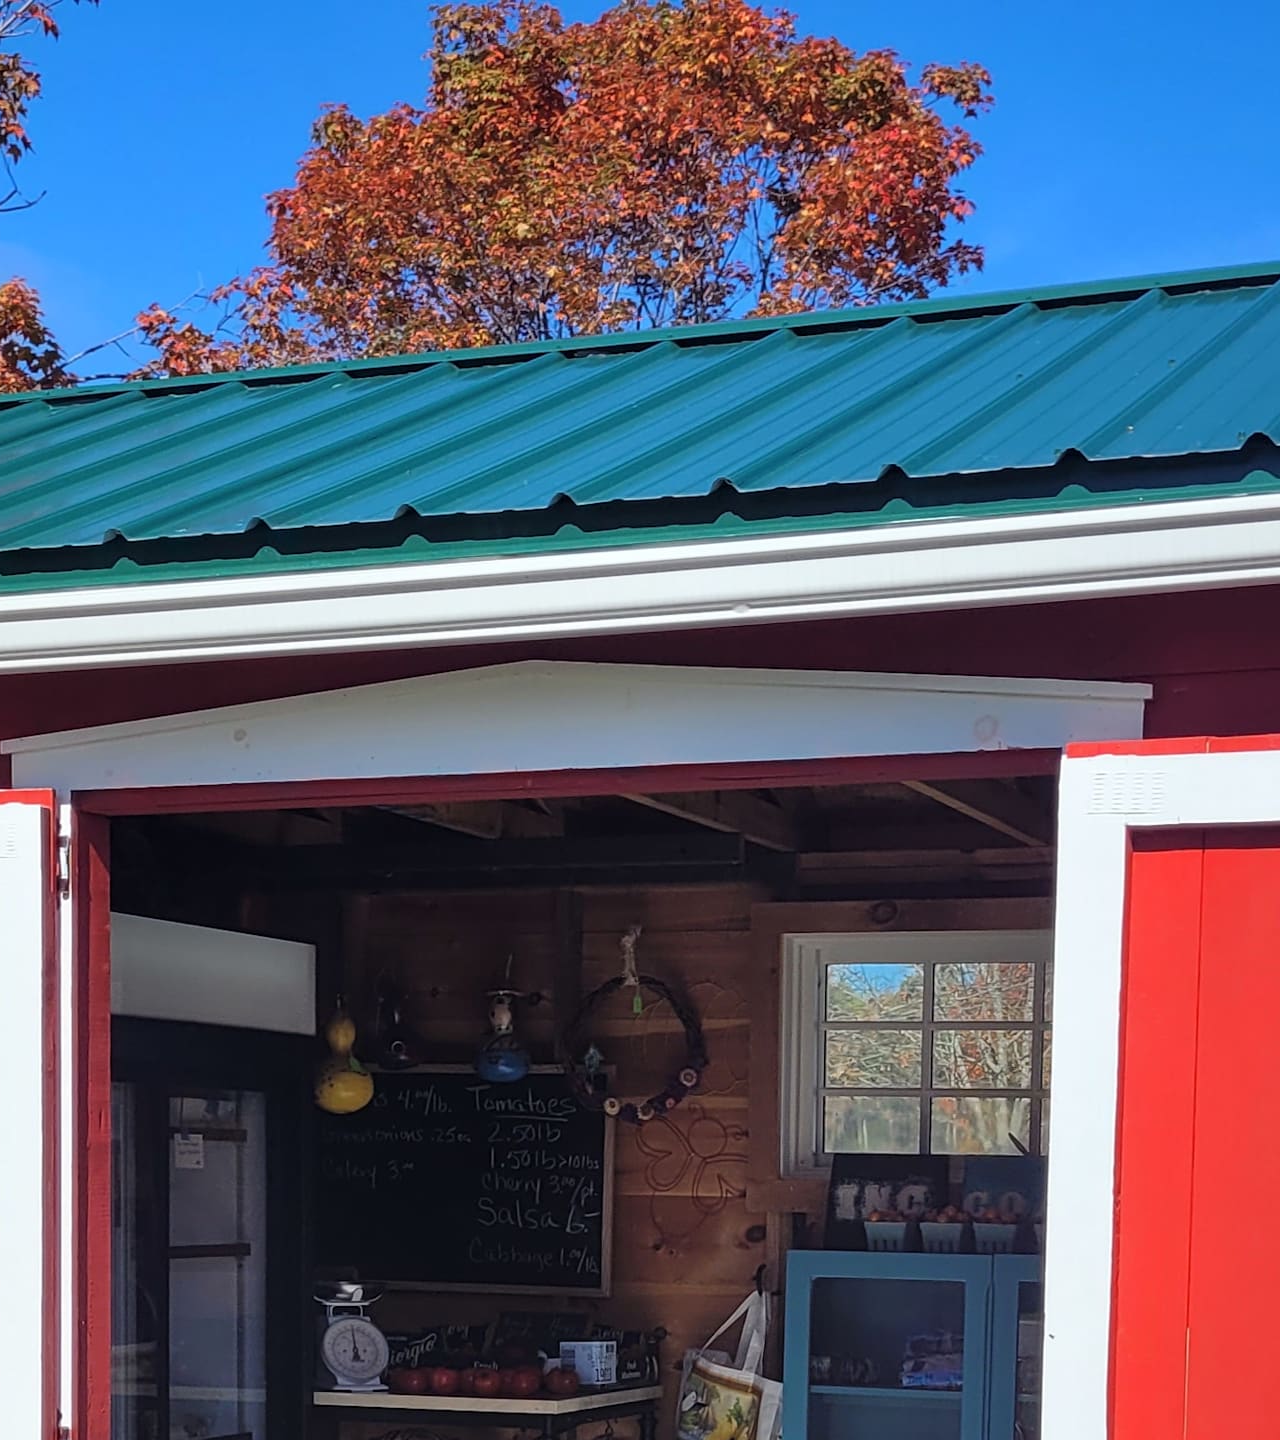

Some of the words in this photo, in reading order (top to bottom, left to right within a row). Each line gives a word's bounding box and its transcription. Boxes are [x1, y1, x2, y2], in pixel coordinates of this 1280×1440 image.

[464, 1084, 577, 1116] Tomatoes
[477, 1197, 559, 1230] Salsa
[387, 1332, 437, 1369] iorgio
